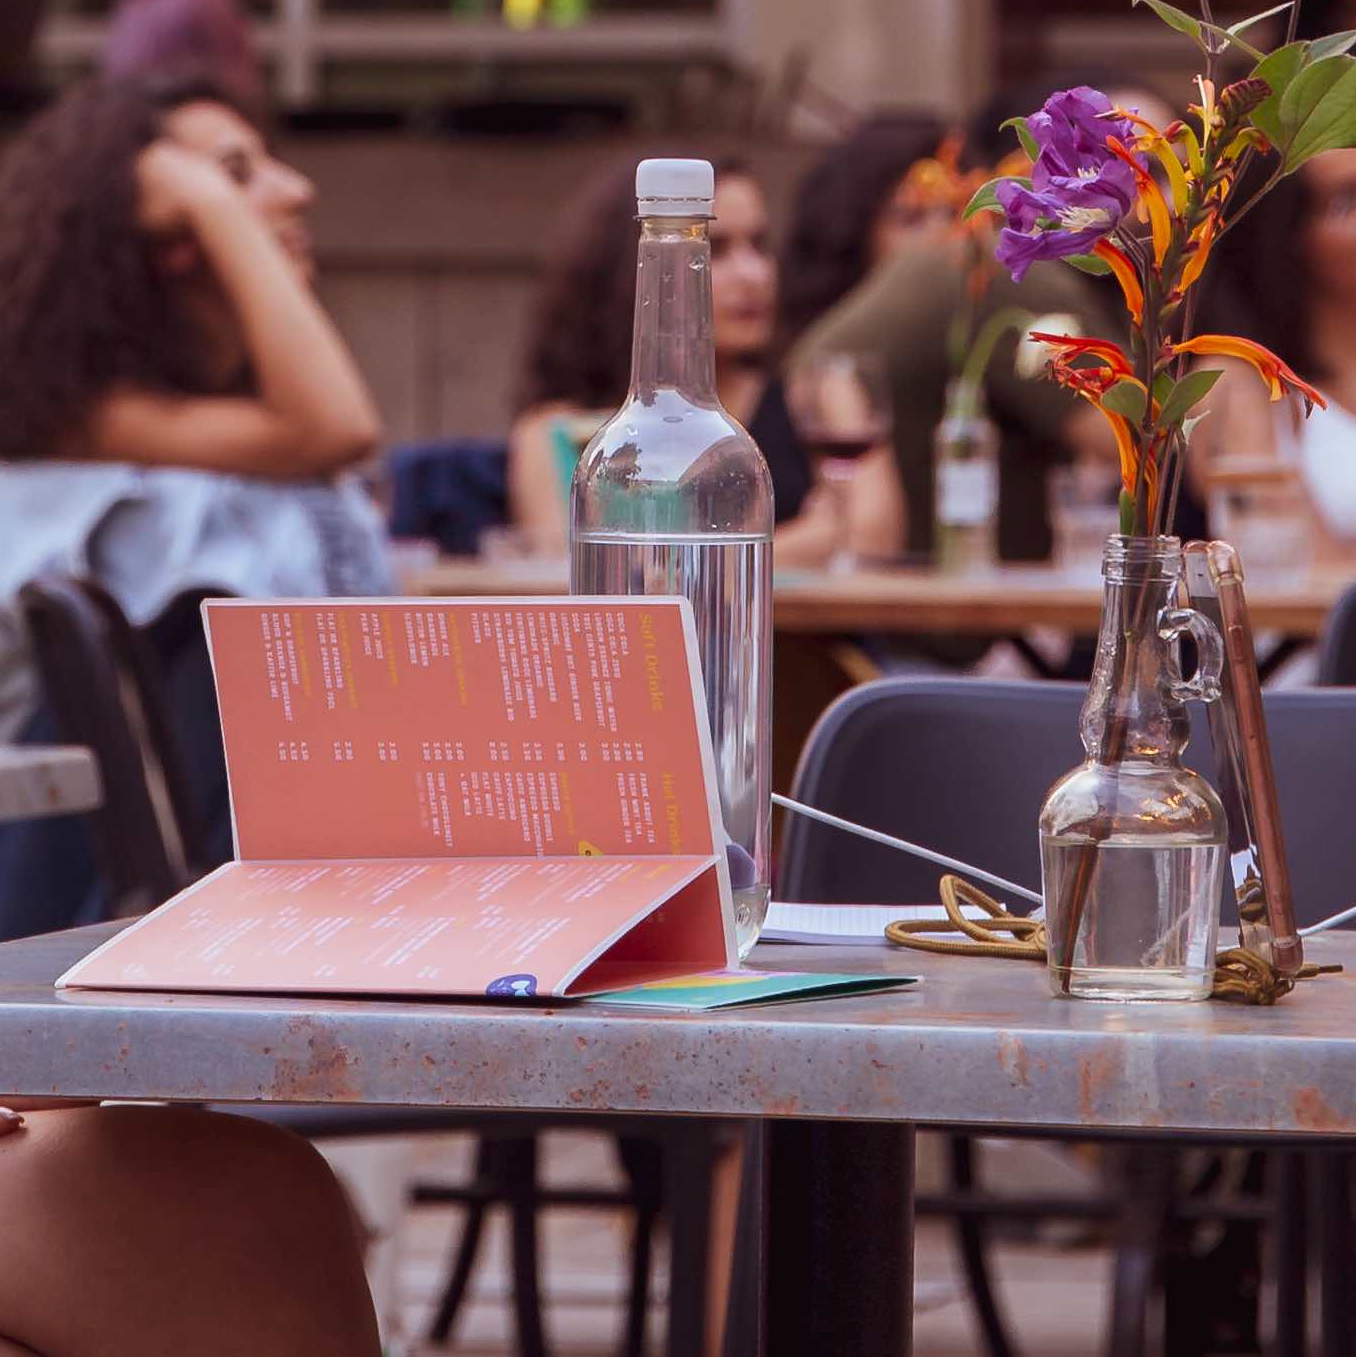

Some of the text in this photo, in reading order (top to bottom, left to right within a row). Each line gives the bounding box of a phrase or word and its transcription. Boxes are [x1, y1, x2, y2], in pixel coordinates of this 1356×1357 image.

[371, 613, 380, 635] APPLE
[605, 612, 613, 632] COCA
[617, 612, 625, 632] COCA
[608, 636, 616, 654] COLA
[620, 636, 628, 655] COLA
[612, 659, 620, 677] ZERO
